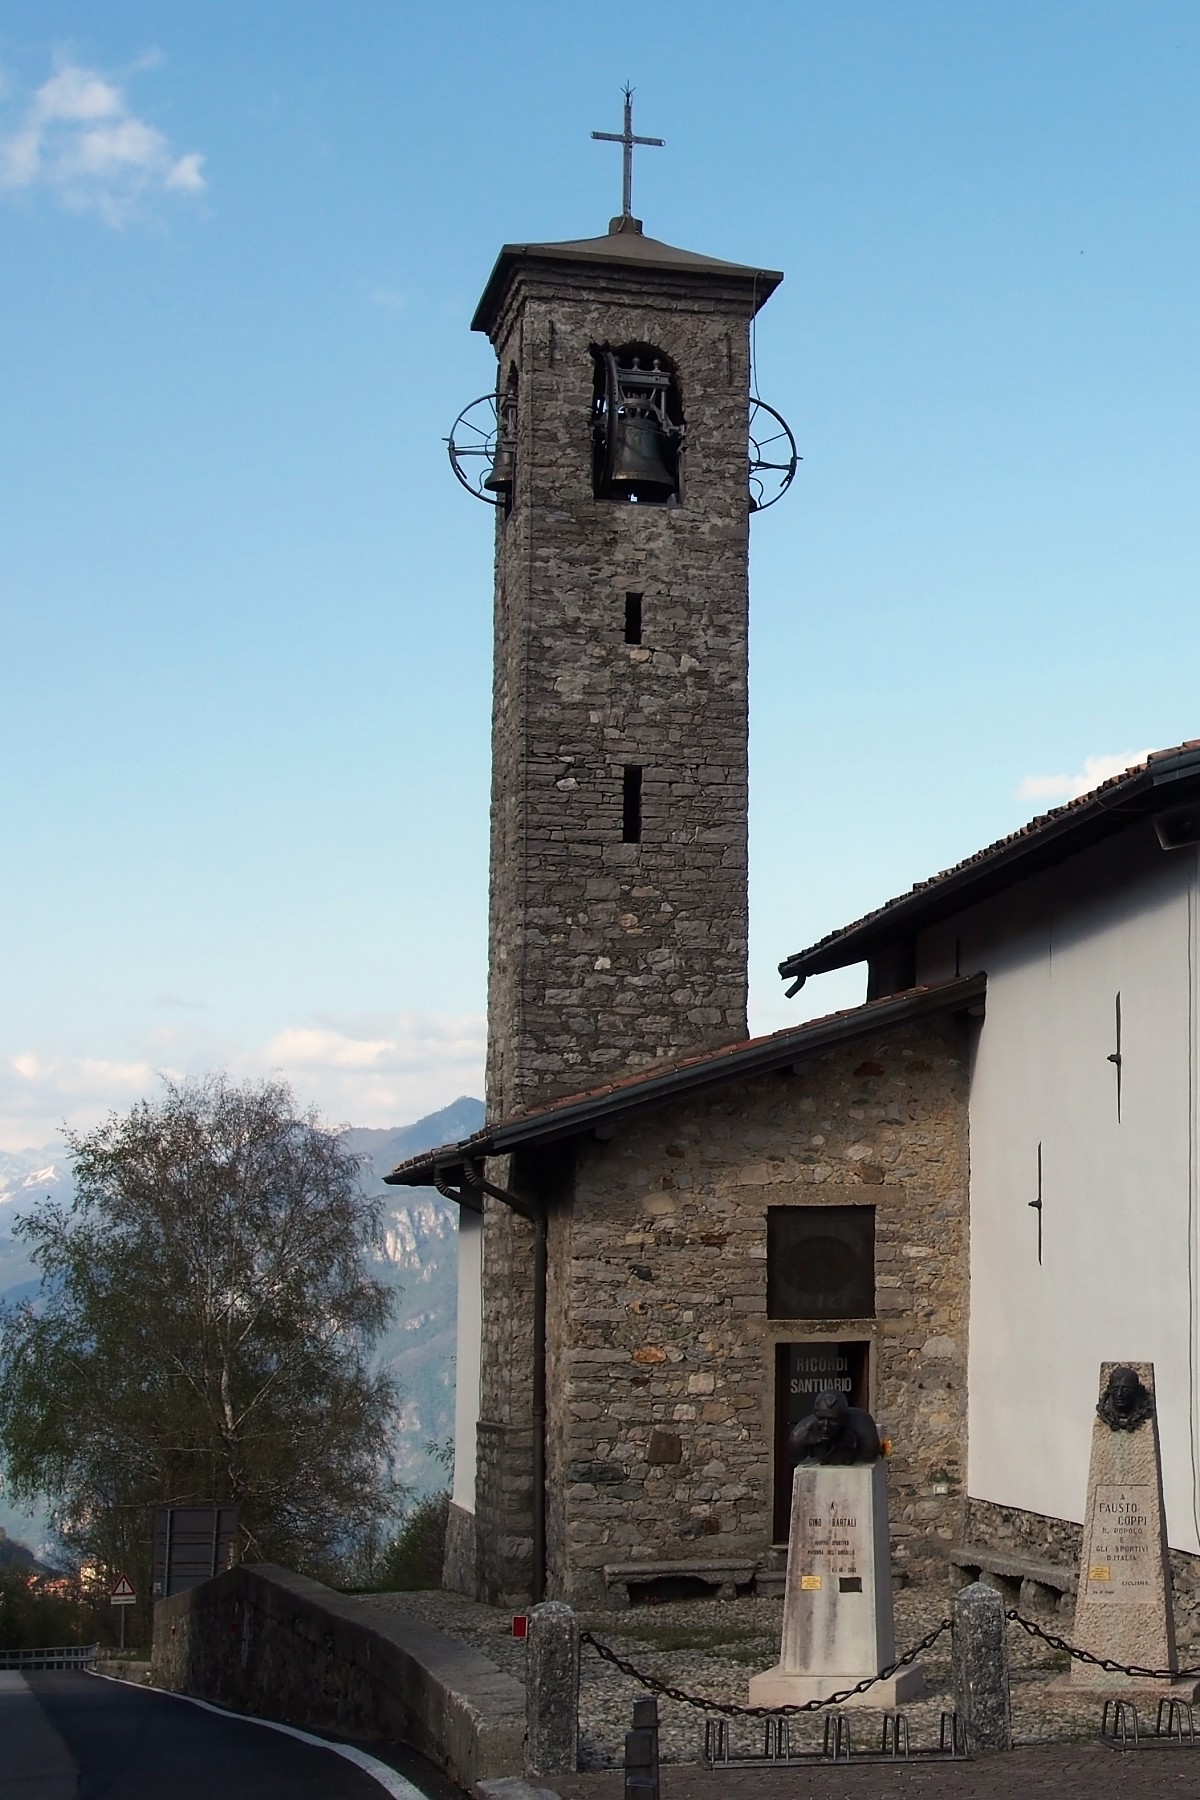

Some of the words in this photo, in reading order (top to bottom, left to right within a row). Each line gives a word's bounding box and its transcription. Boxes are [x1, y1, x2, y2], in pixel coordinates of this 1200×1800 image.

[796, 1357, 848, 1372] RICORDI
[790, 1377, 852, 1394] SANTUARIO
[830, 1501, 835, 1510] A
[1099, 1502, 1138, 1513] FAUSTO
[808, 1518, 822, 1528] GINO
[831, 1518, 857, 1528] BARTALI
[1117, 1516, 1147, 1526] COPPI
[1113, 1527, 1143, 1535] POPOLO
[1115, 1545, 1149, 1553] SPORTIVI
